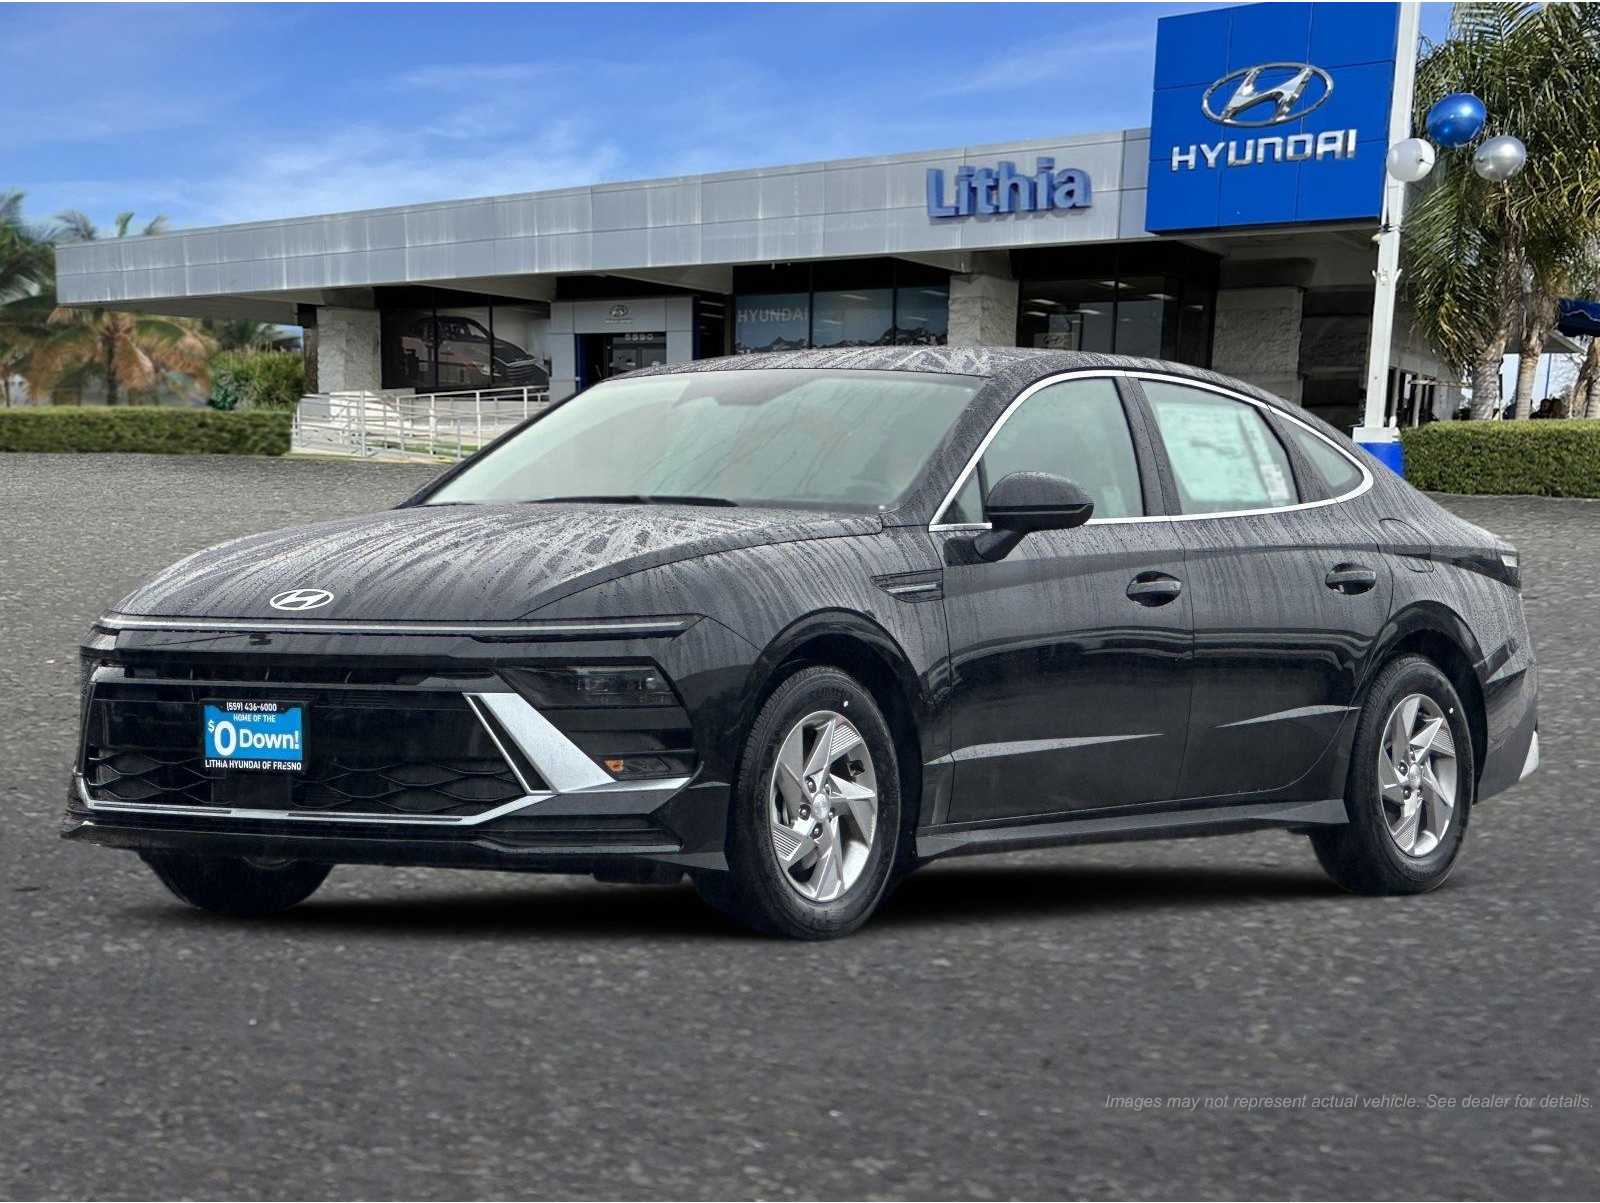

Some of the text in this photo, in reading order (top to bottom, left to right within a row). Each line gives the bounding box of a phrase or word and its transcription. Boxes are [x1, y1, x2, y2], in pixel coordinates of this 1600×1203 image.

[1171, 129, 1357, 171] HYUNDAI
[926, 156, 1093, 218] Lithia
[736, 308, 809, 322] HYUNDAI
[226, 702, 277, 712] (559) 436-6000
[233, 714, 276, 724] HOME OF THE
[208, 720, 300, 757] $0 Down!
[205, 760, 302, 772] LITHIA HYUNDAI OF FRESNO
